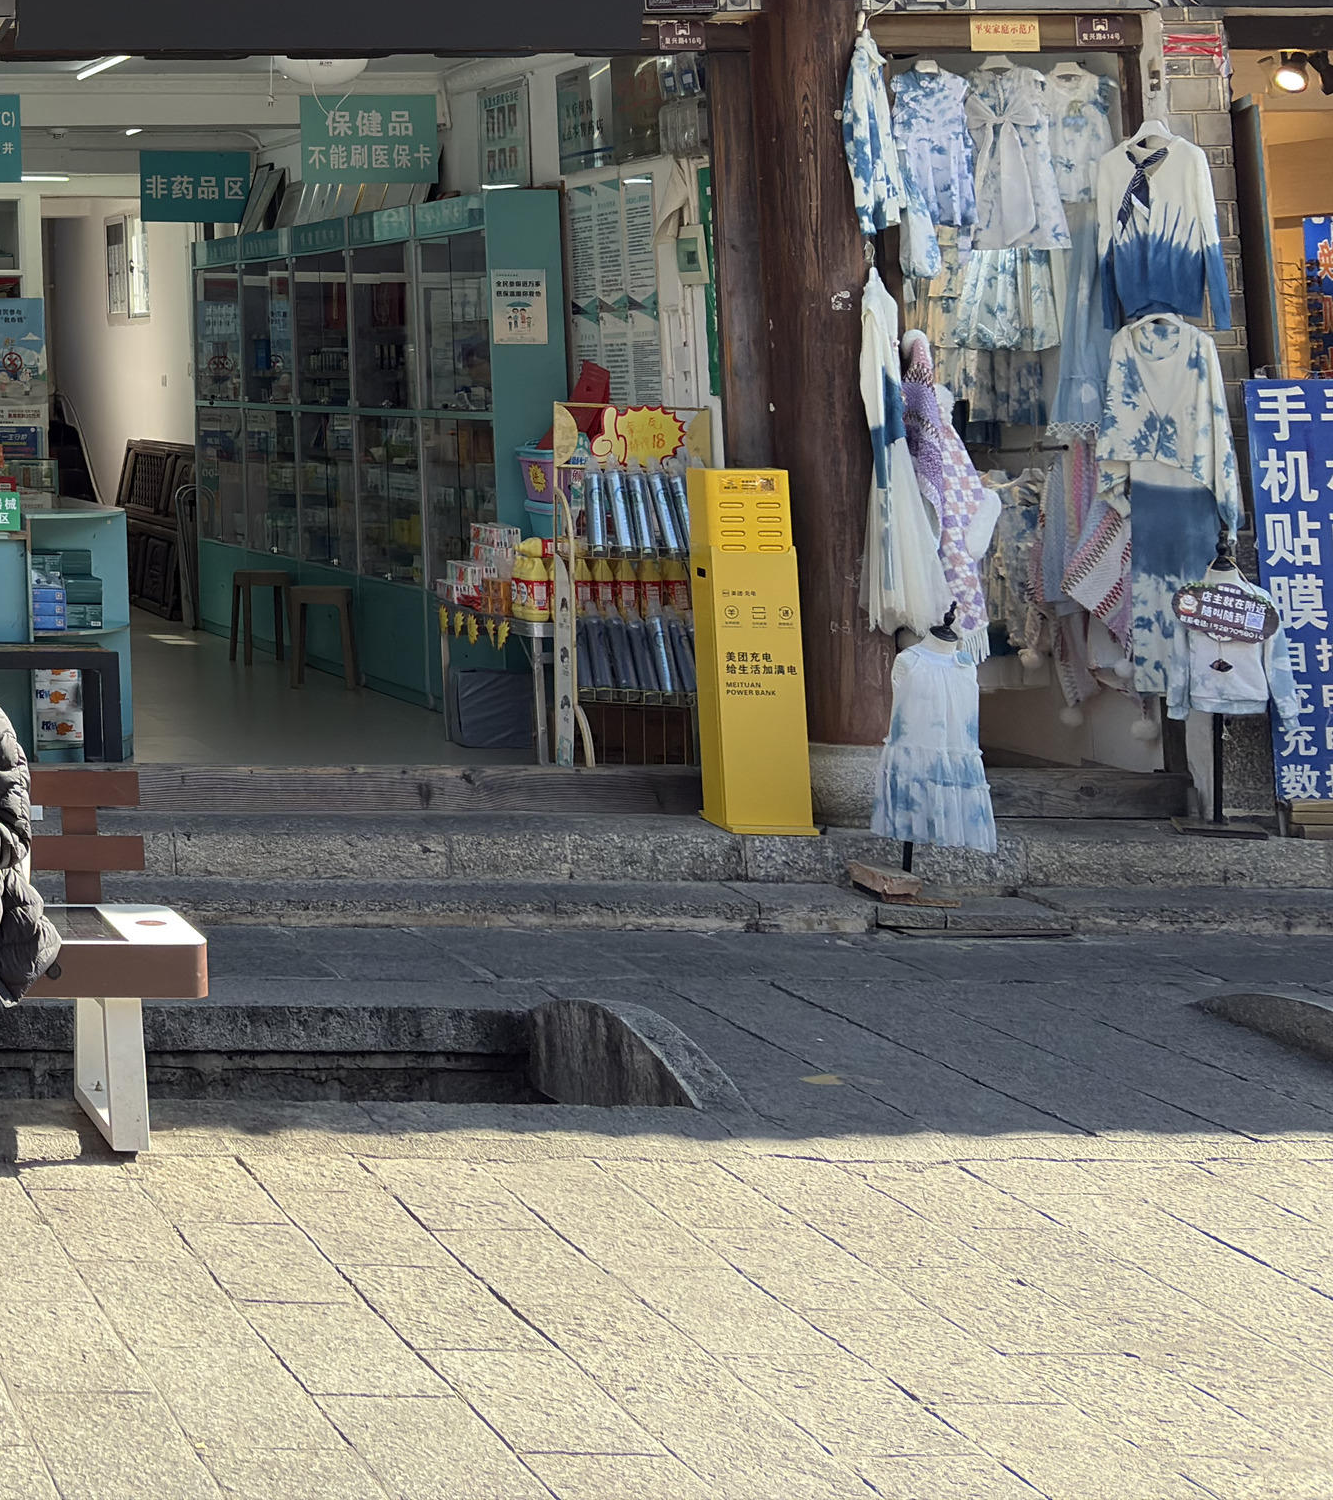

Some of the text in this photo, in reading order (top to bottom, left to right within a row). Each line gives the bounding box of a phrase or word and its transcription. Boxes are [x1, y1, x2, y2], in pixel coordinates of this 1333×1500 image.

[974, 23, 1037, 35] 平安家庭示范户
[1081, 32, 1121, 41] 复兴路414号
[325, 110, 413, 137] 保健品
[308, 144, 432, 171] 不能刷医保卡
[145, 175, 245, 200] 非药品区
[1254, 385, 1328, 630] 手机贴膜
[1201, 590, 1267, 615] 店主就在附近
[1201, 604, 1245, 625] 随叫随到
[725, 652, 773, 663] 美团充电
[725, 664, 798, 676] 给生活加满电
